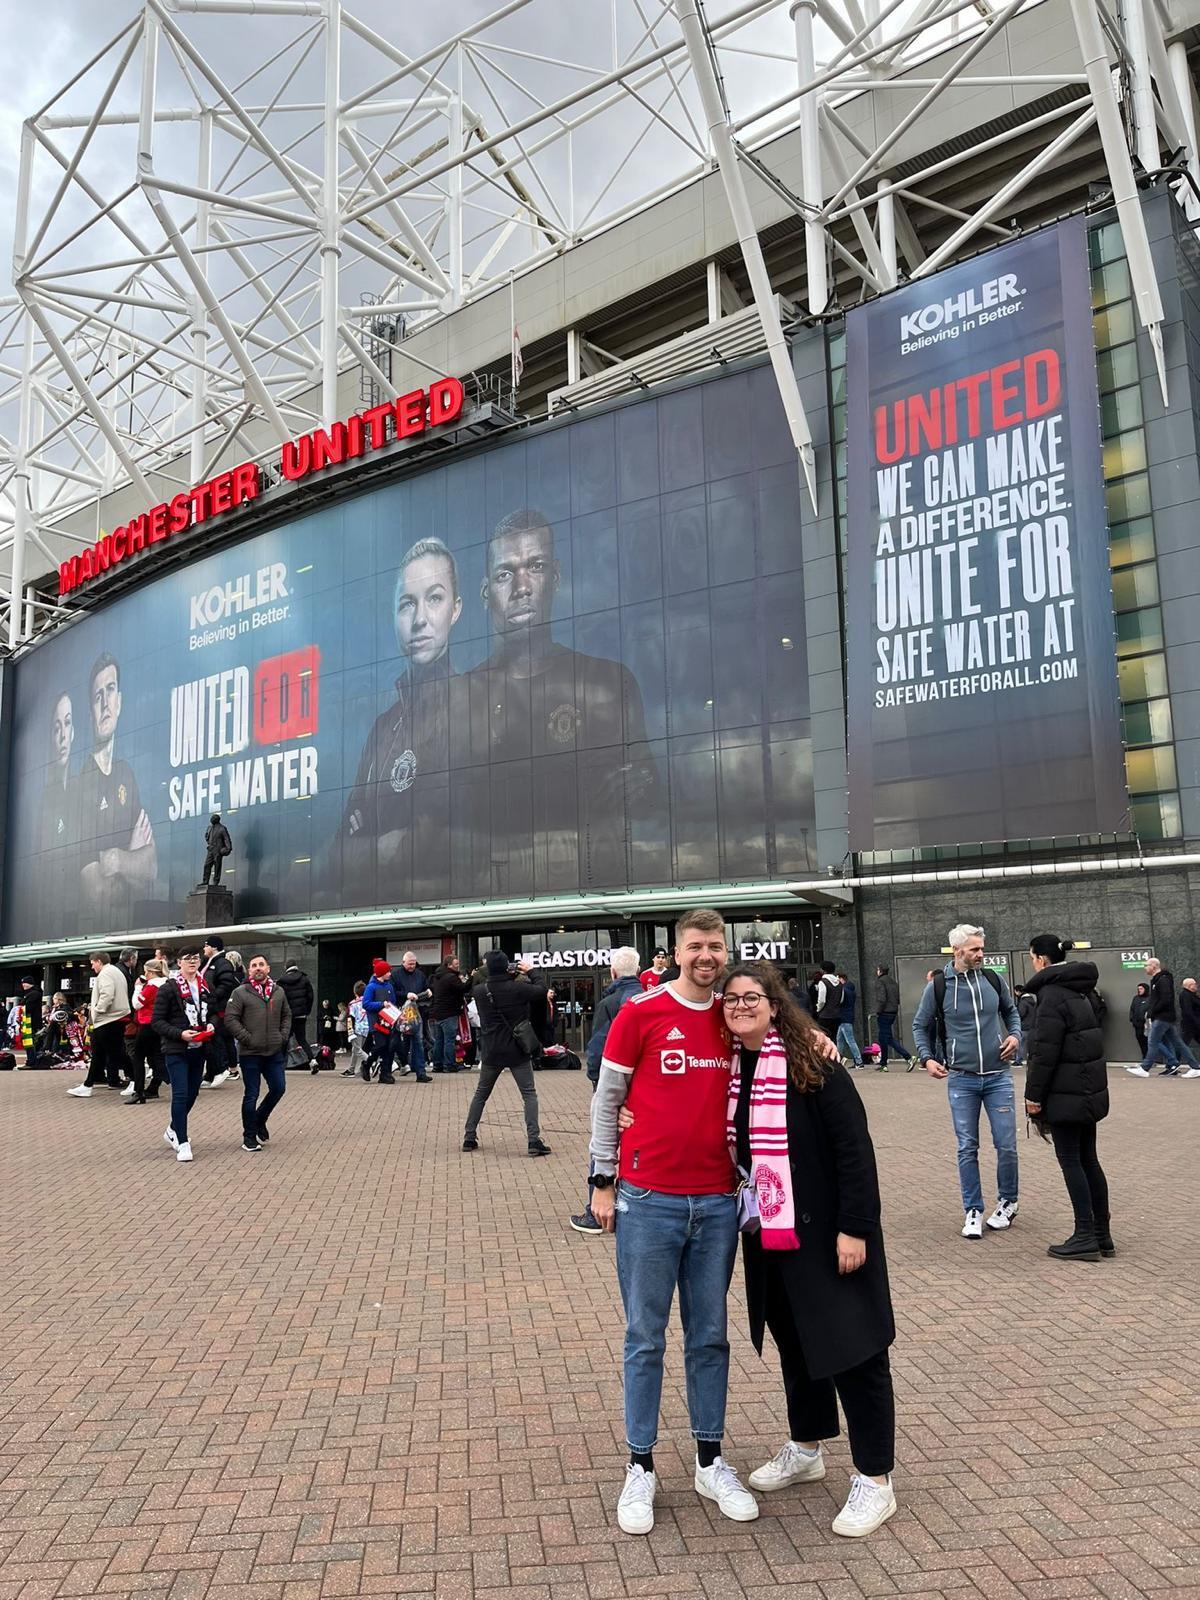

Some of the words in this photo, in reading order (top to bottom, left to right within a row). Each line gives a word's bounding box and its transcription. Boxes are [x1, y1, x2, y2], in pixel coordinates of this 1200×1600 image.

[901, 325, 959, 355] Believing
[962, 319, 975, 332] in
[978, 301, 1024, 326] Better.
[874, 348, 1061, 464] UNITED
[59, 462, 259, 594] MANCHESTER
[281, 377, 464, 481] UNITED
[877, 462, 914, 519] WE
[924, 443, 976, 507] CAN
[986, 414, 1065, 491] MAKE
[876, 522, 895, 556] A
[901, 473, 1073, 551] DIFFERENCE.
[876, 537, 981, 632] UNITE
[997, 515, 1074, 609] FOR
[189, 624, 236, 650] Believing
[238, 618, 250, 634] in
[876, 628, 934, 684] SAFE
[944, 610, 1031, 673] WATER
[1044, 599, 1075, 657] AT
[170, 665, 250, 768] UNITED
[260, 668, 310, 729] FOR
[875, 657, 1078, 708] SAFEWATERFORALL.COM
[168, 766, 223, 822] SAFE
[229, 746, 318, 809] WATER
[740, 941, 790, 961] EXIT
[983, 956, 1007, 966] EX13
[1121, 951, 1149, 962] EX14
